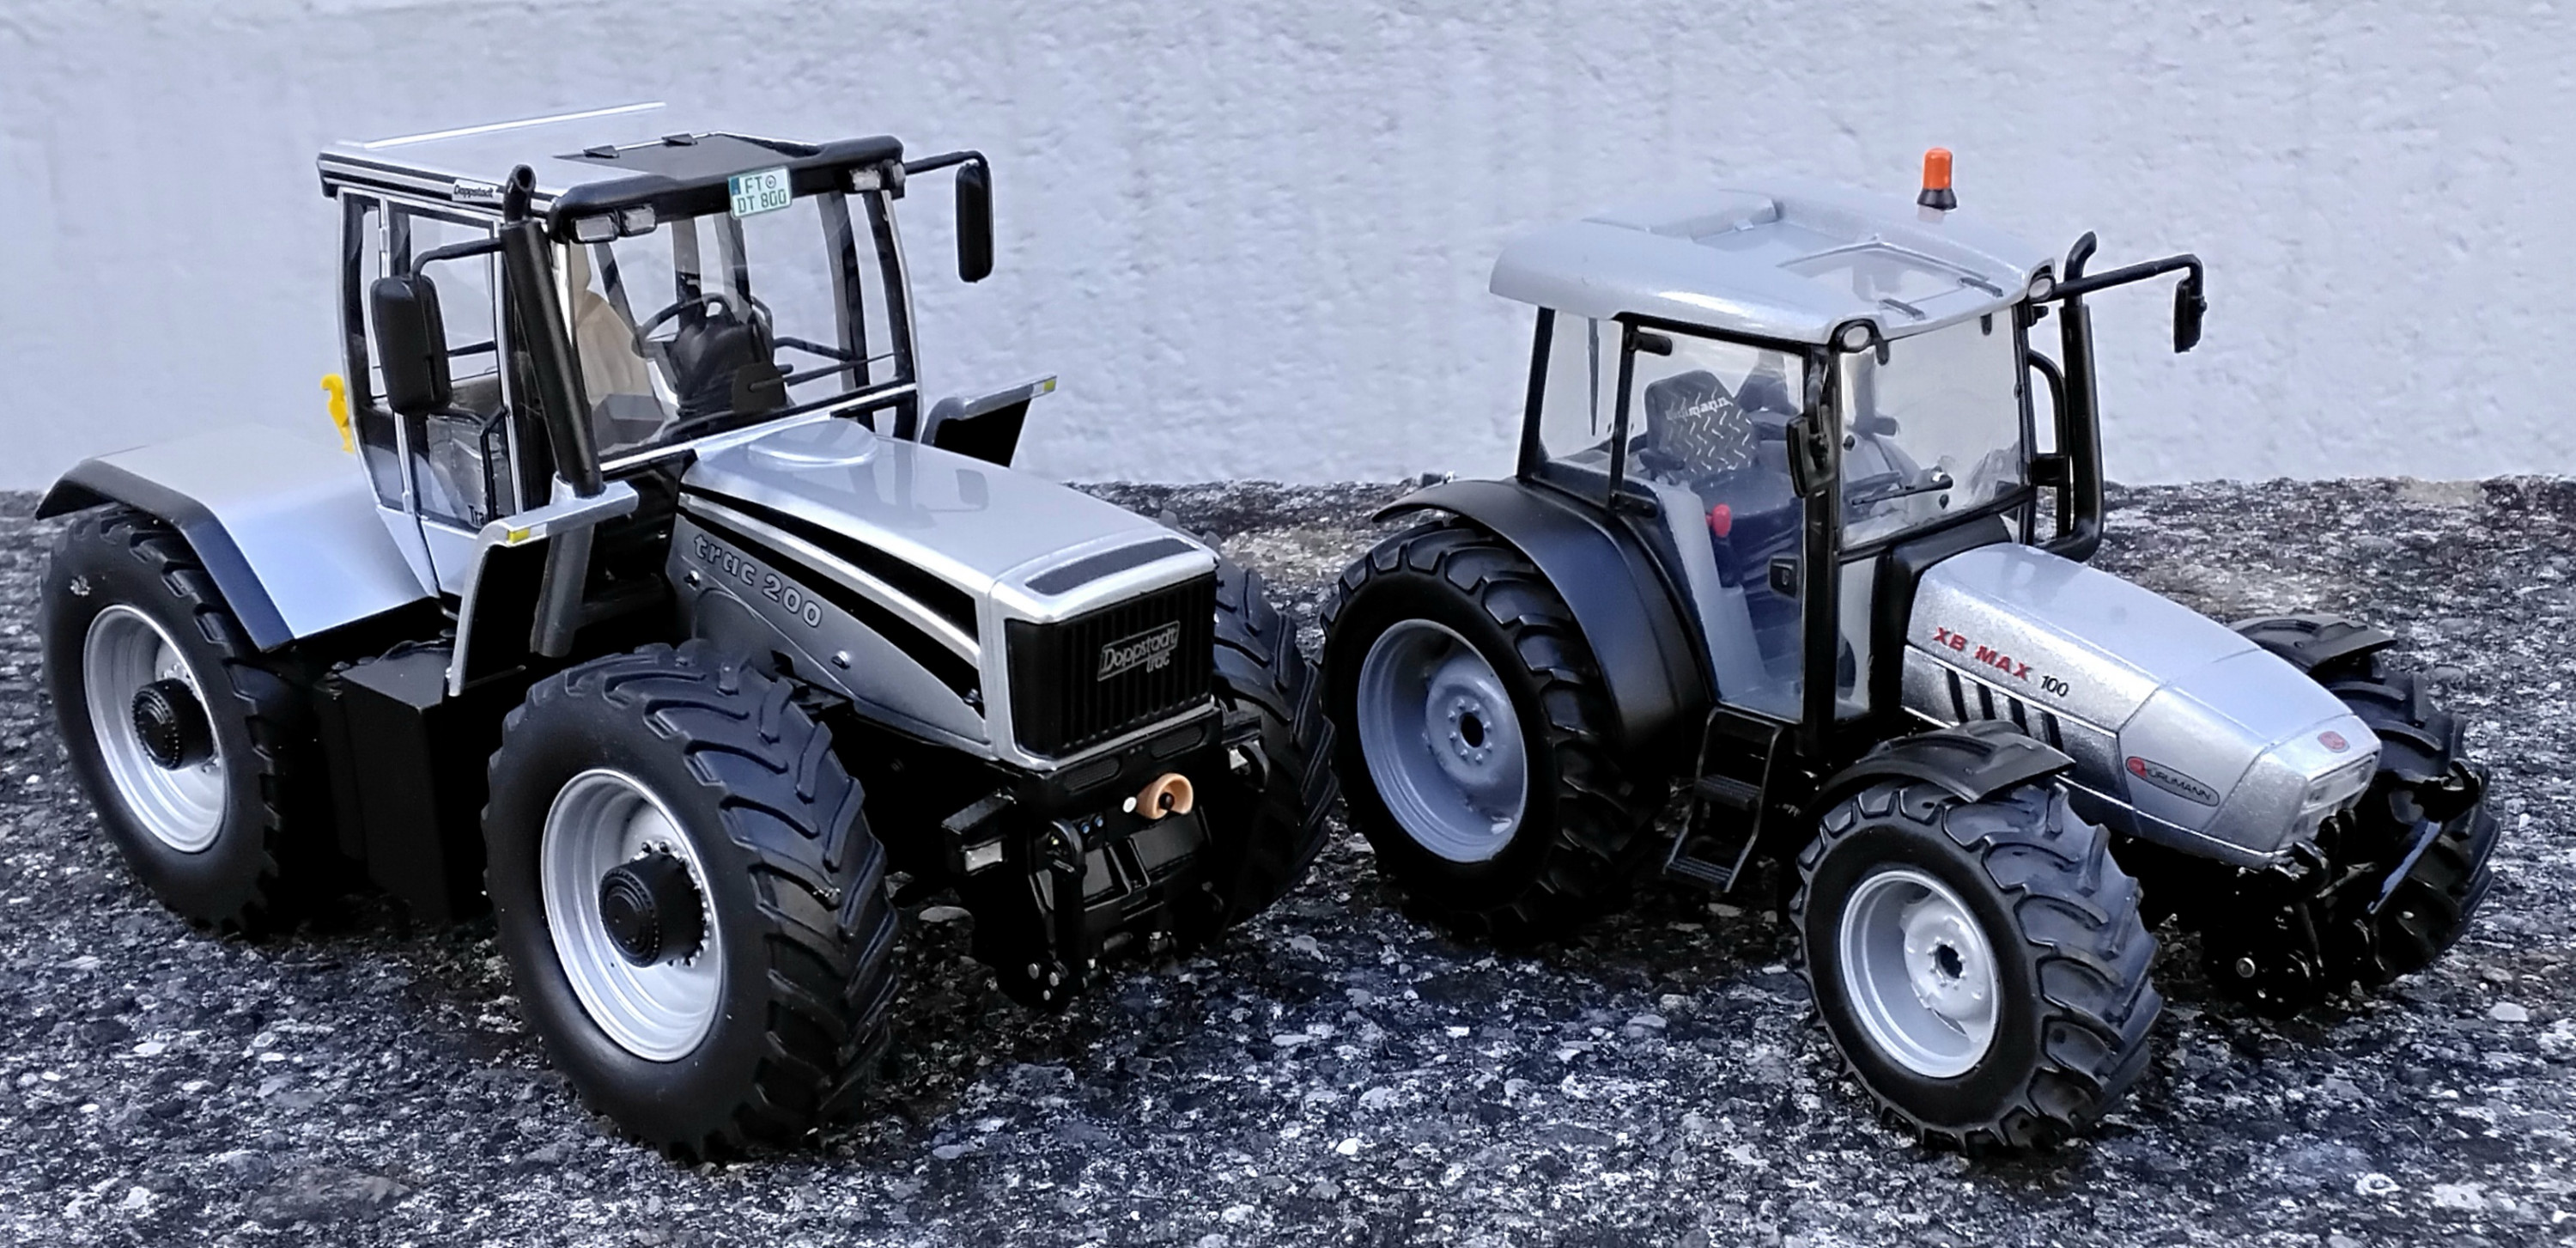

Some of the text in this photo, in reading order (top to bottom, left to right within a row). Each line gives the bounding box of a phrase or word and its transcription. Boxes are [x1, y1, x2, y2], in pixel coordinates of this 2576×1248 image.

[453, 184, 494, 198] Doppstadt
[744, 175, 762, 194] FT
[737, 189, 787, 213] DT 800
[468, 504, 486, 525] Tra
[694, 533, 823, 629] trac 200
[1101, 627, 1176, 673] Doppstadt
[1932, 626, 2069, 697] XB MAX 100
